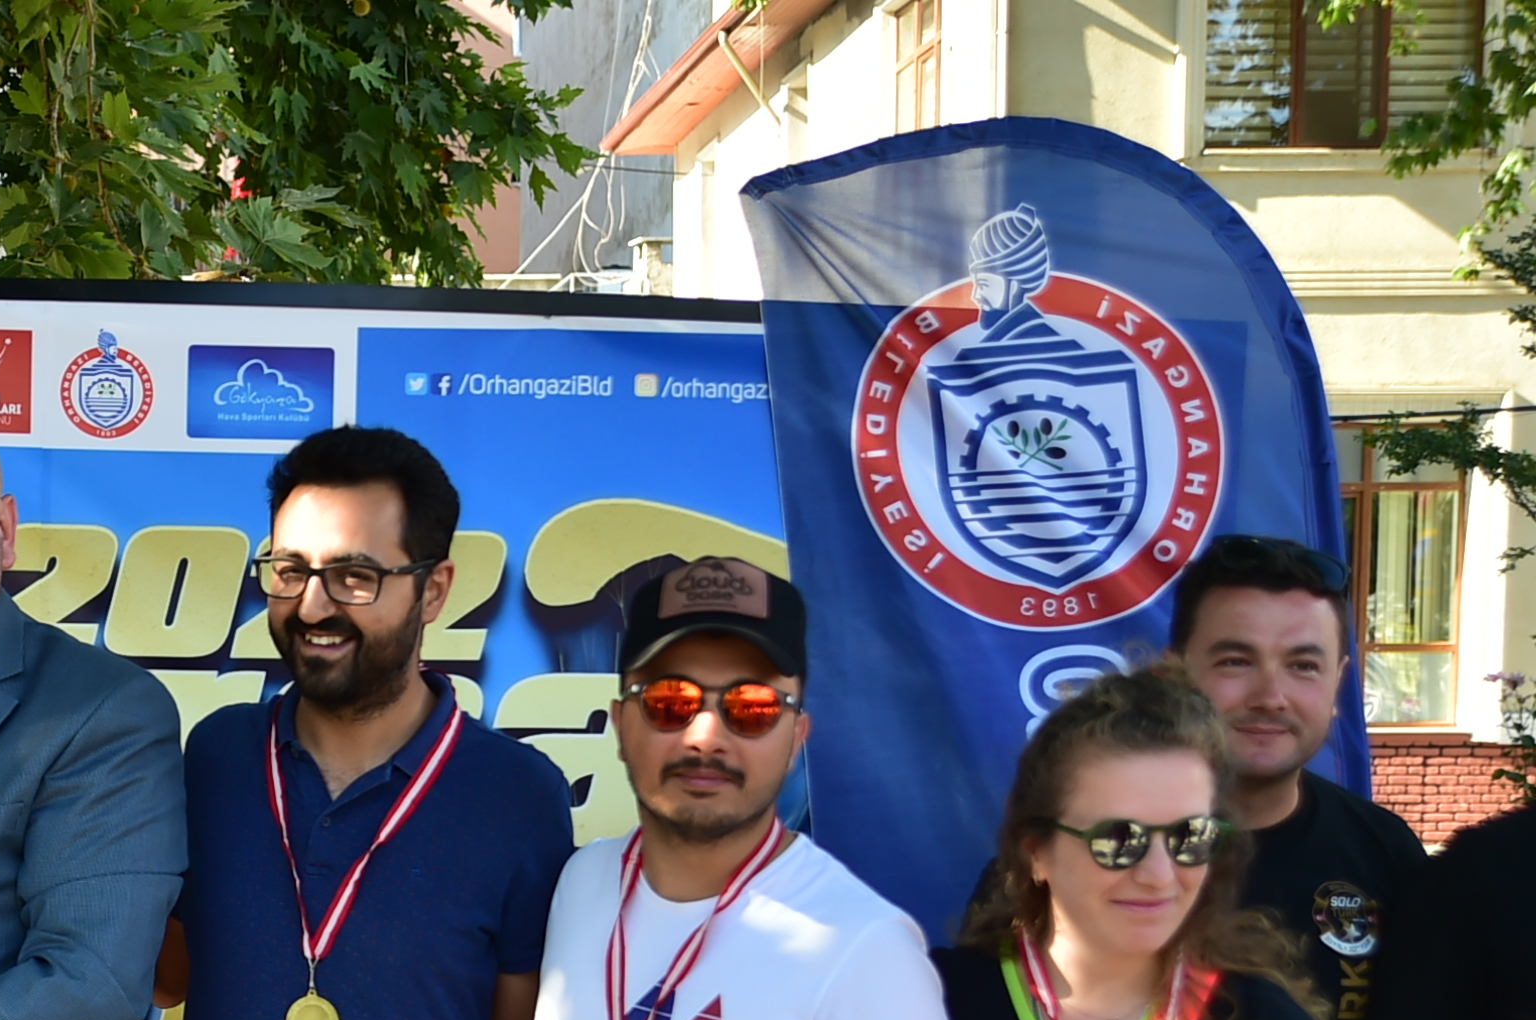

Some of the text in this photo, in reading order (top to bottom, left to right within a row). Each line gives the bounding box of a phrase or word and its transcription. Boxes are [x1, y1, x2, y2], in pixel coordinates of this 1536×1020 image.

[458, 373, 613, 399] /OrhangaziBld
[662, 376, 771, 404] /orhangaz
[217, 413, 240, 421] Hava
[1330, 895, 1362, 907] SOLO
